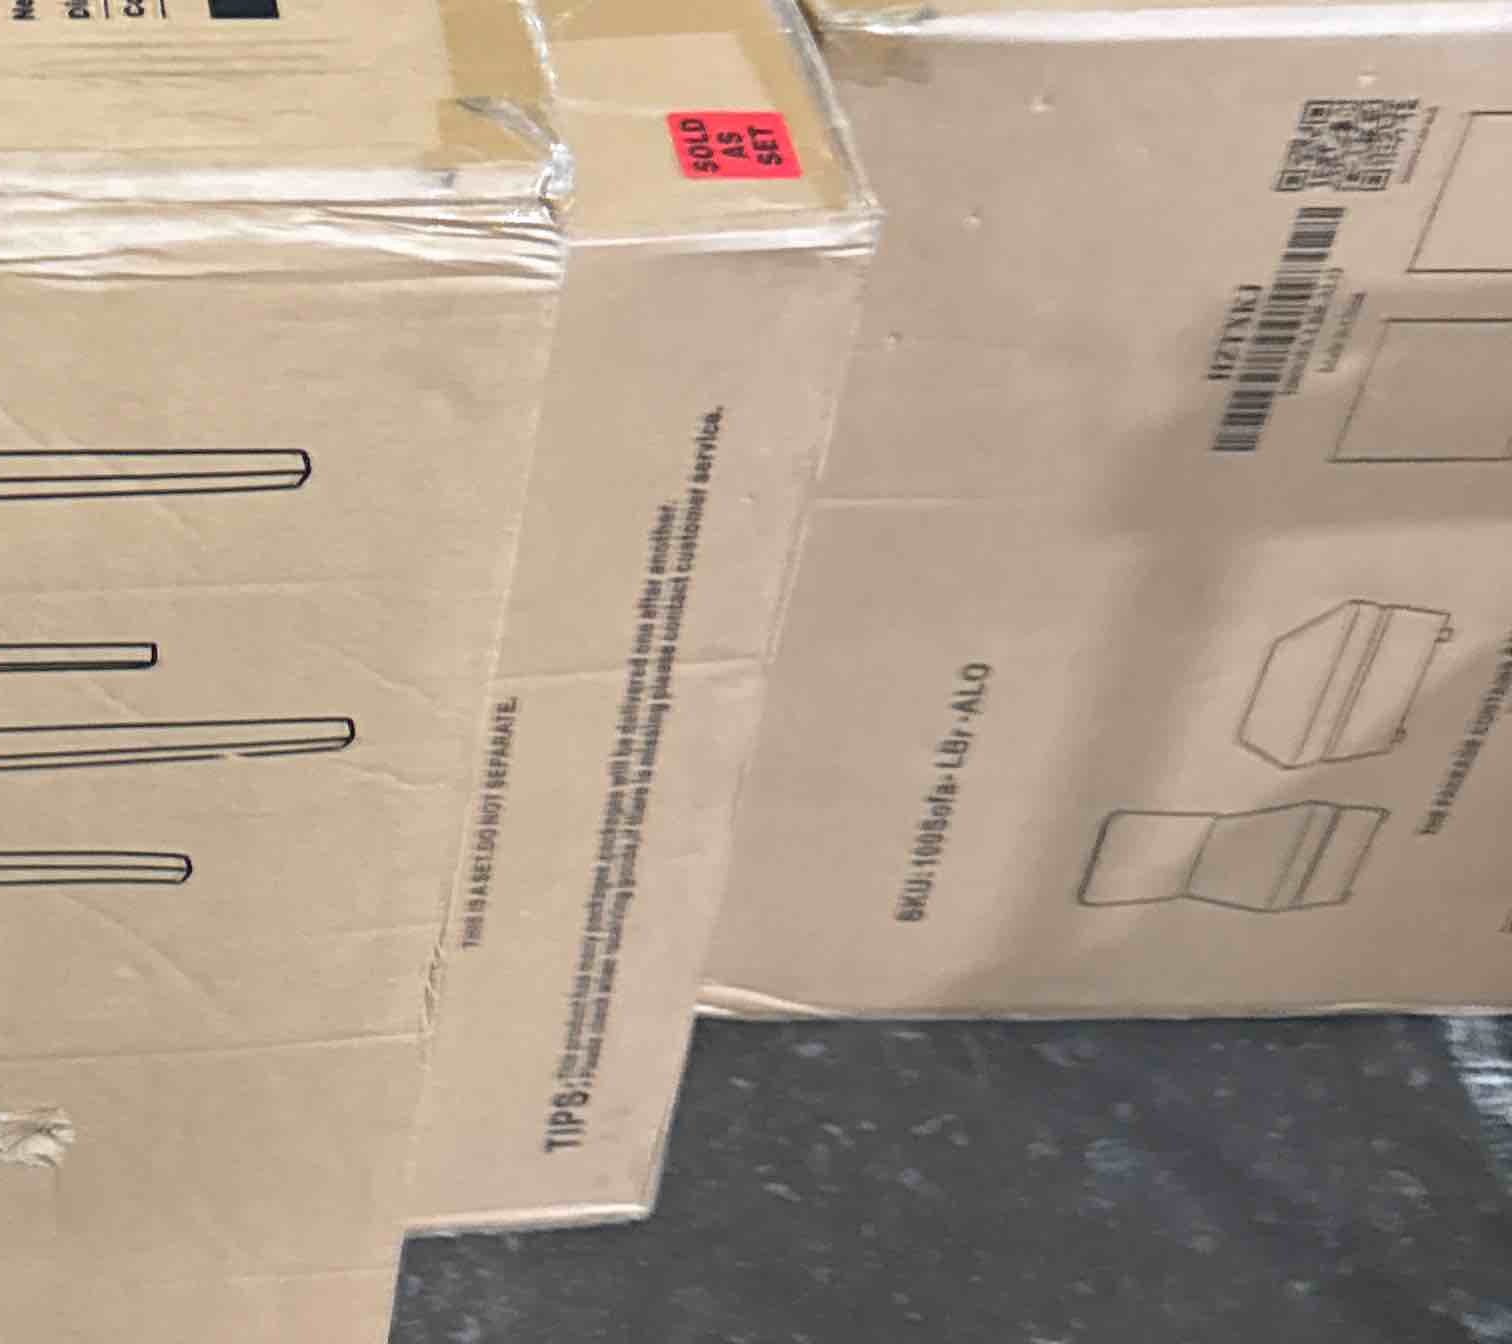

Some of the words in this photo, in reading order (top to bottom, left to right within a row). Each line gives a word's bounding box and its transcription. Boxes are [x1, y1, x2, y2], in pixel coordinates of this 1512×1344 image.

[678, 118, 719, 173] SOLD
[715, 131, 748, 159] AS
[747, 126, 782, 166] SET
[674, 488, 709, 573] customer
